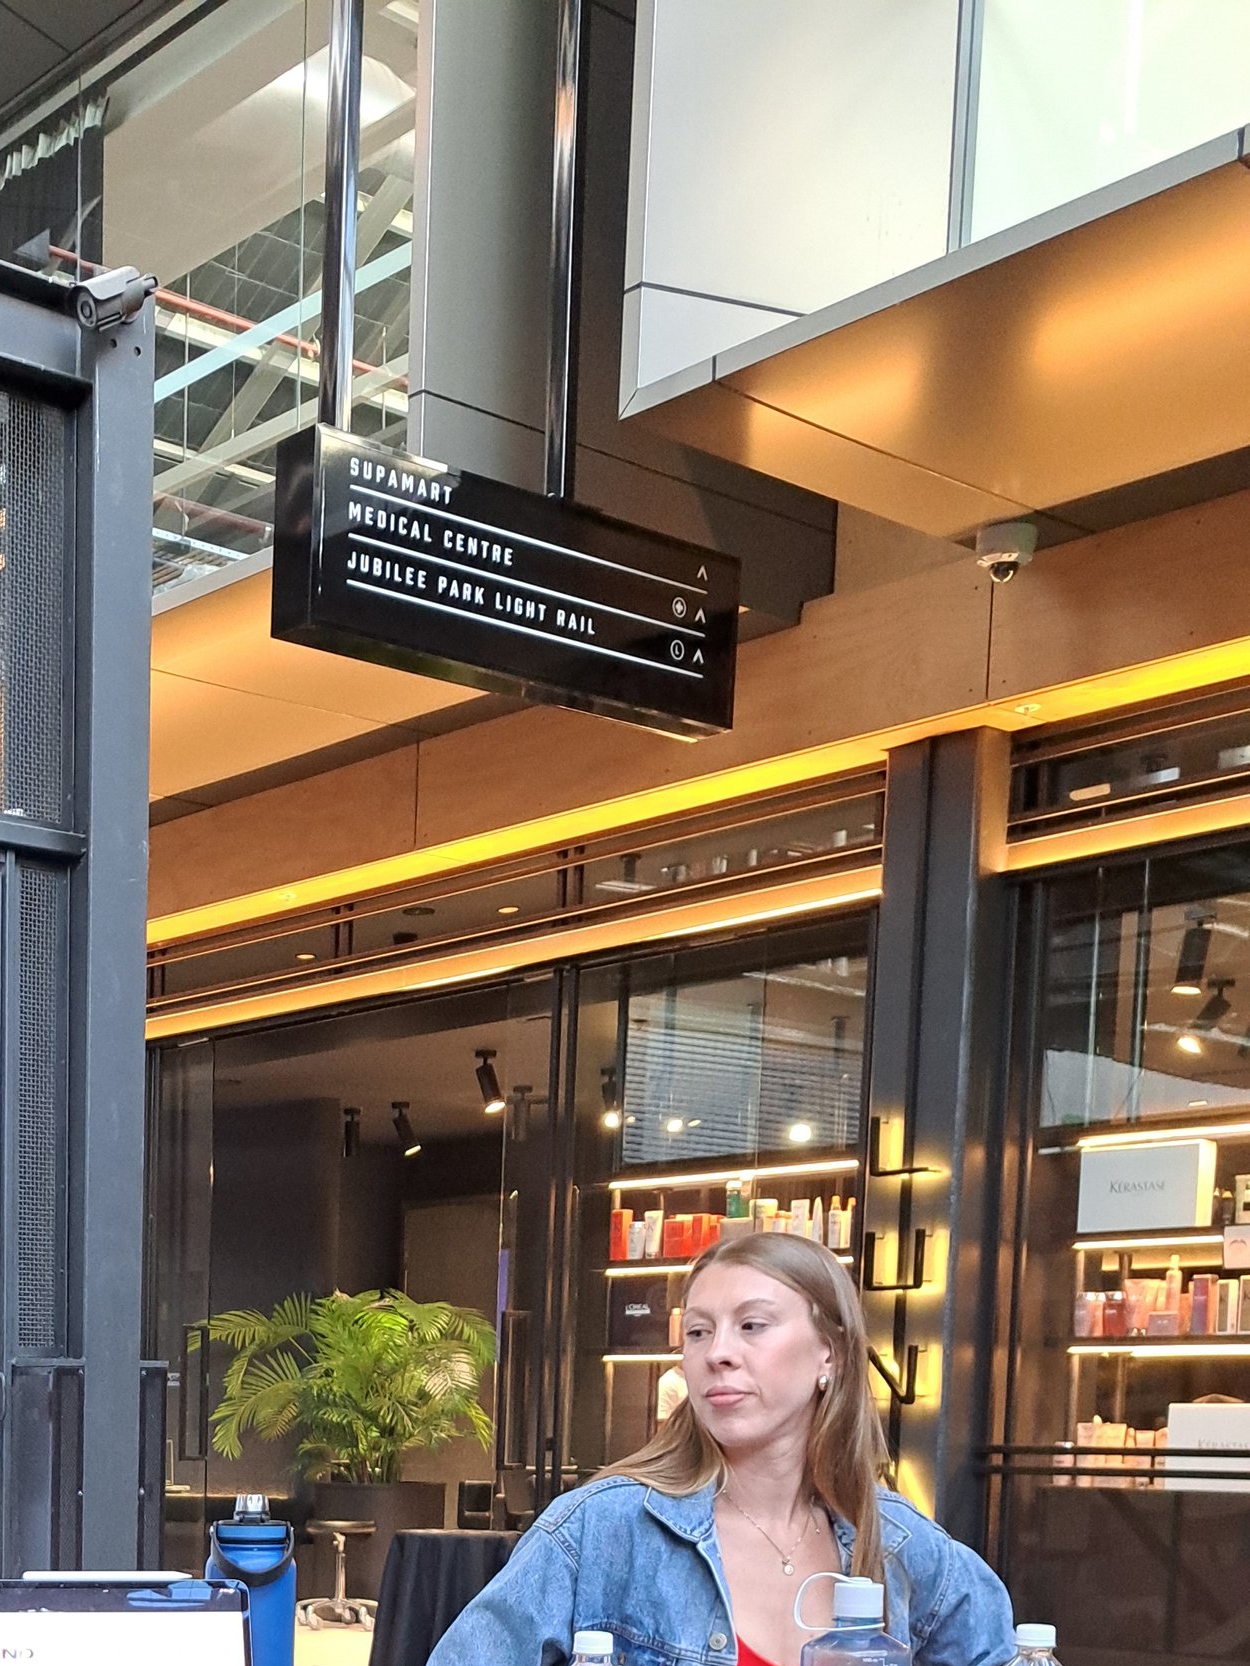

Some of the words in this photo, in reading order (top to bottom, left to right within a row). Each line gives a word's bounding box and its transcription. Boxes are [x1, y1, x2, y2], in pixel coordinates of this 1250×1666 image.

[350, 457, 452, 505] SUPAMART
[348, 501, 432, 543] MEDICAL
[443, 530, 513, 566] CENTRE
[347, 551, 426, 589] JUBILEE
[438, 576, 485, 605] PARK
[495, 592, 547, 622] LIGHT
[556, 609, 596, 635] RAIL
